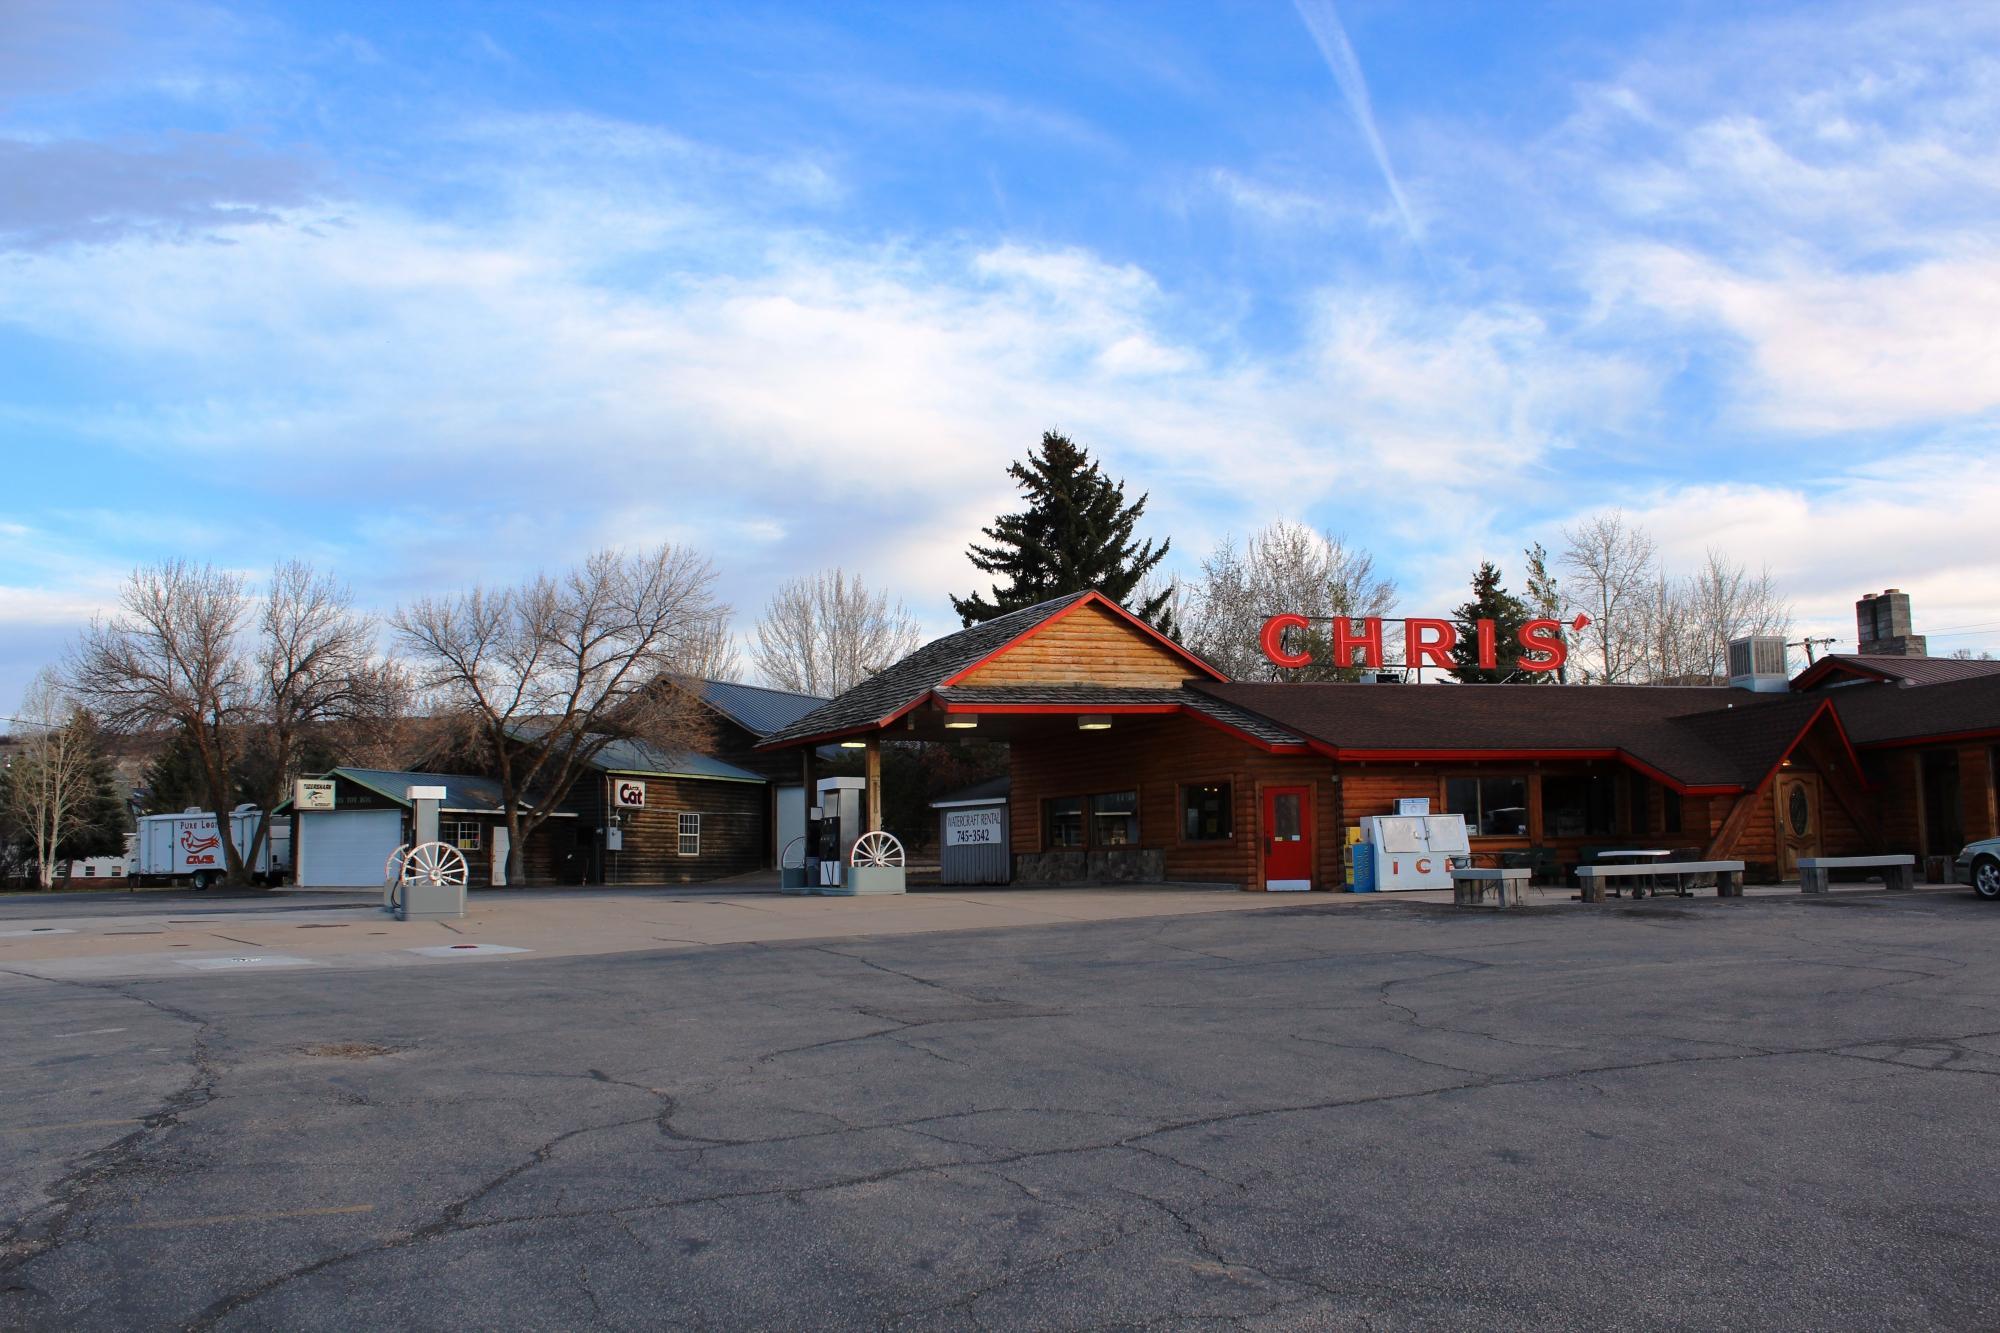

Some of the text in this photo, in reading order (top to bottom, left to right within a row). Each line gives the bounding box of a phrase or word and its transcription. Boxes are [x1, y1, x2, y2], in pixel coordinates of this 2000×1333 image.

[1259, 612, 1593, 672] CHRIS'
[620, 783, 642, 804] Cat
[947, 812, 1000, 828] WATERCRAFT RENTAL
[957, 829, 990, 843] 745-3542
